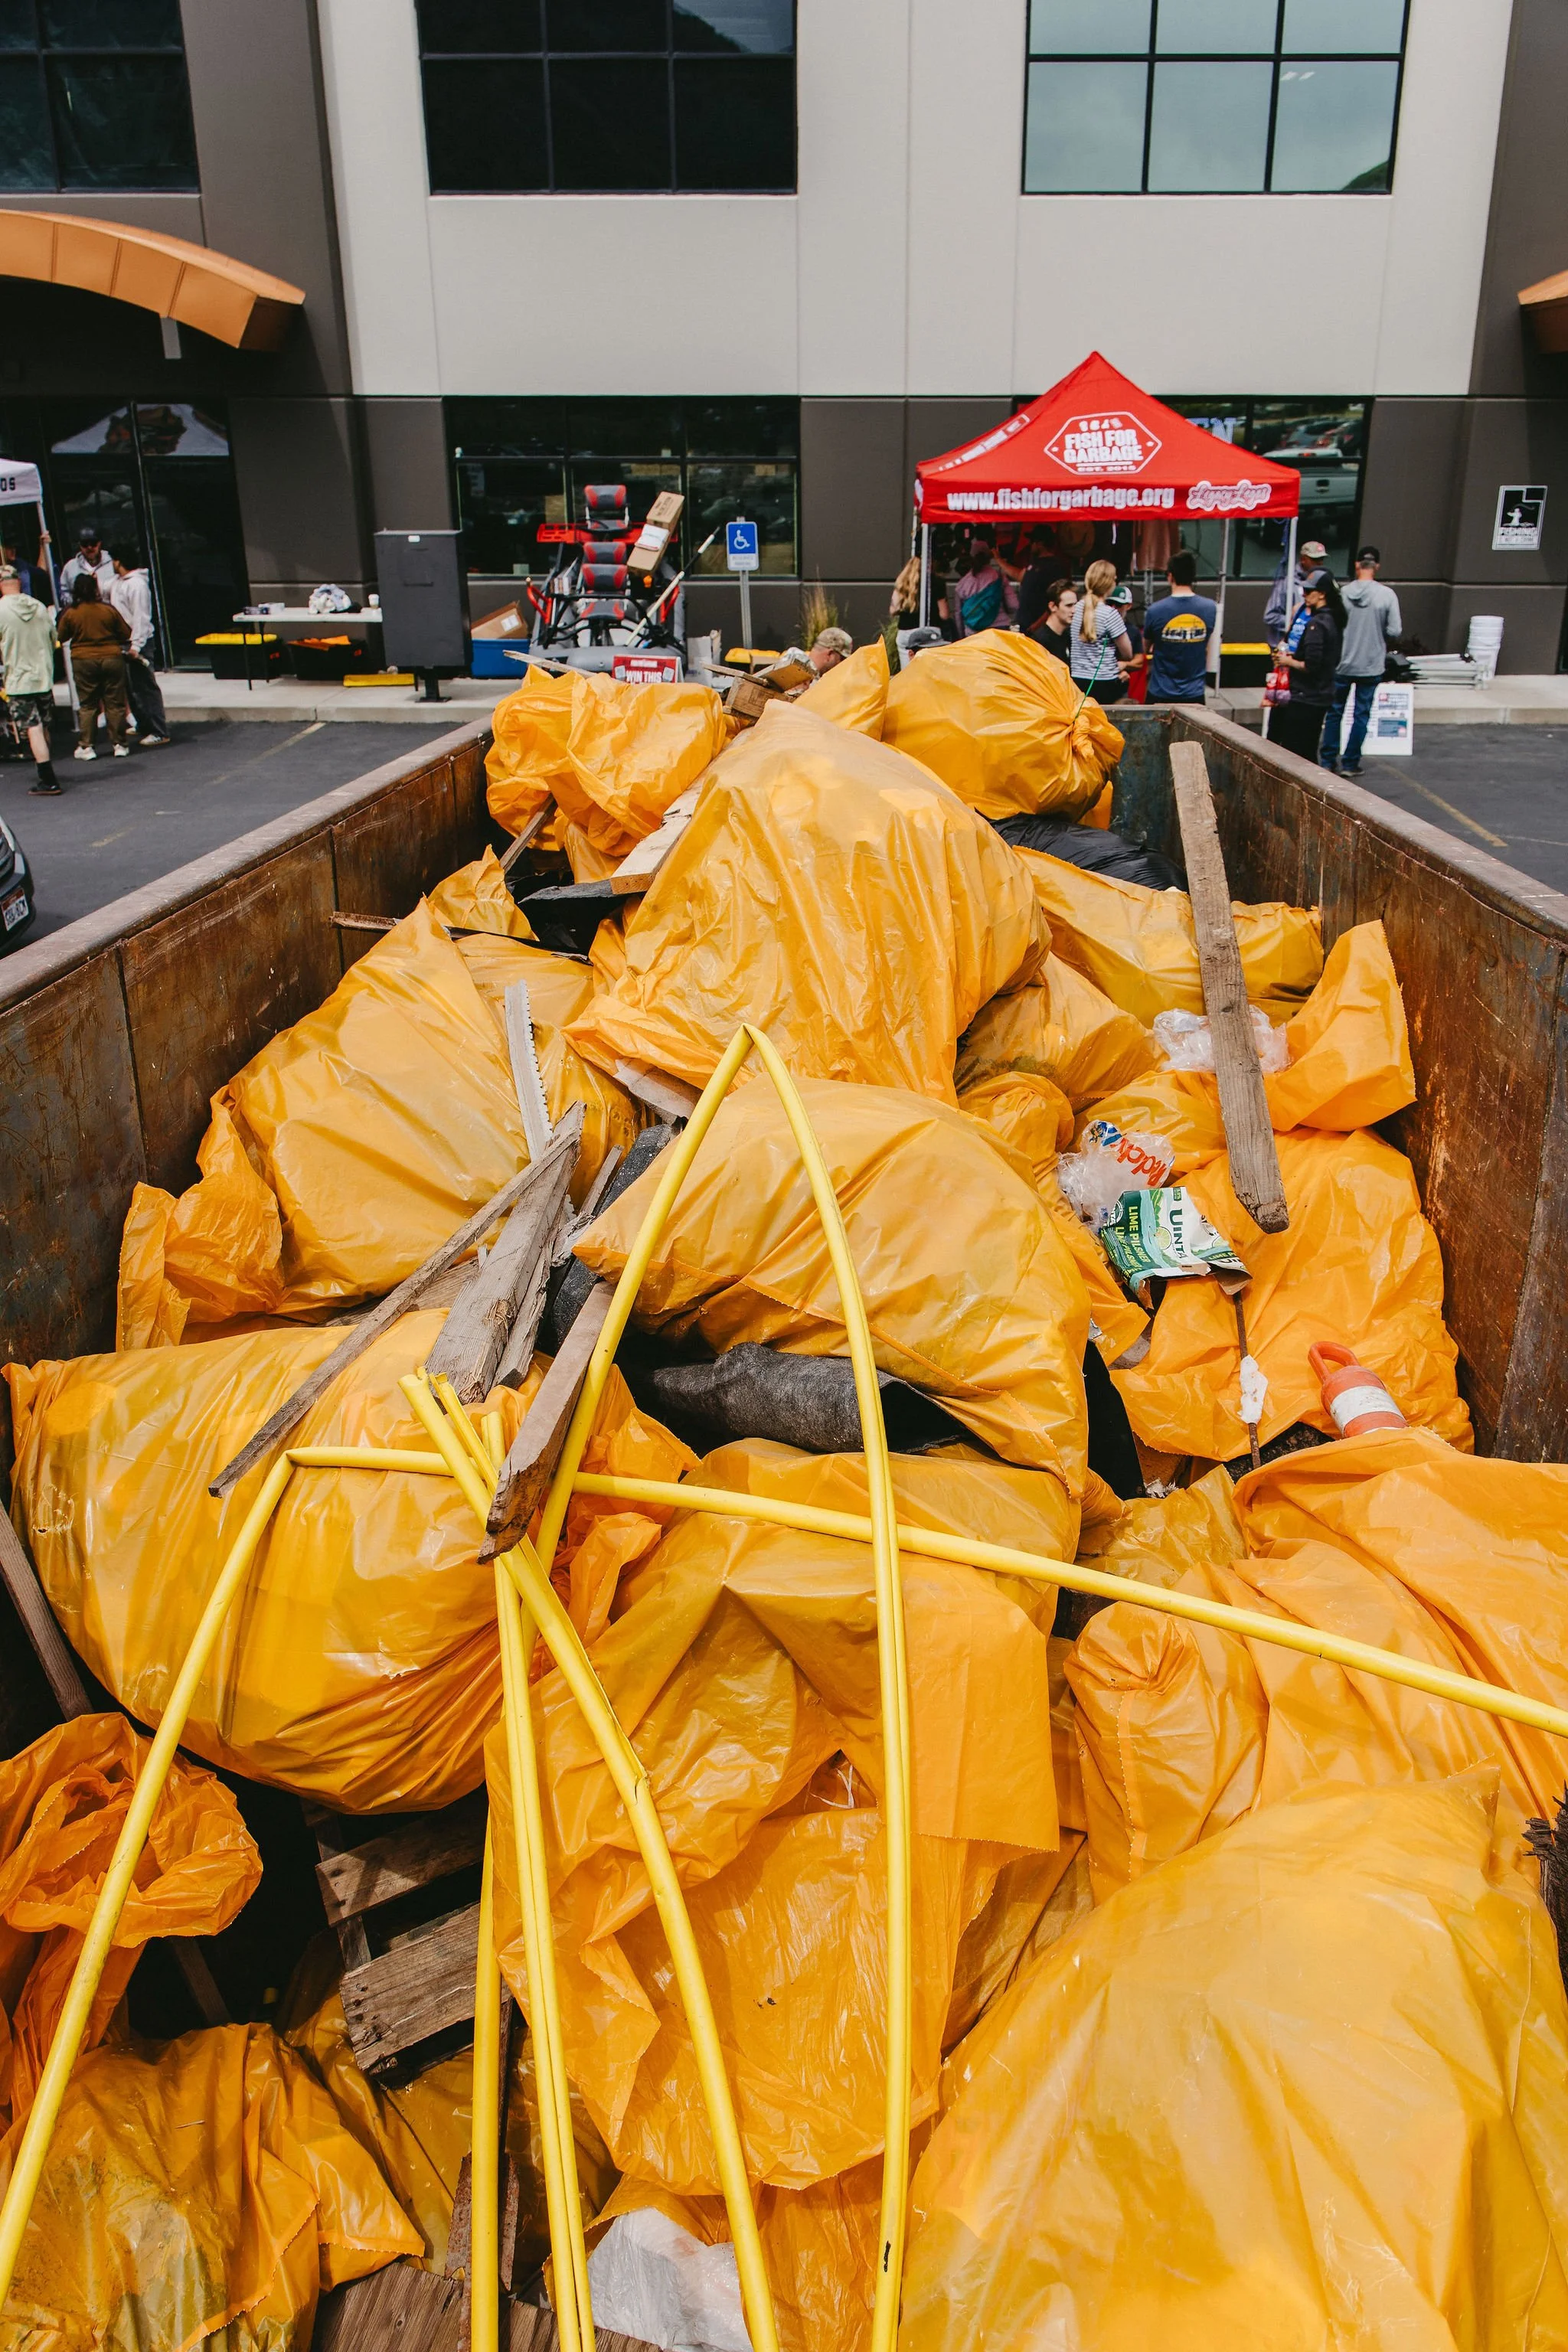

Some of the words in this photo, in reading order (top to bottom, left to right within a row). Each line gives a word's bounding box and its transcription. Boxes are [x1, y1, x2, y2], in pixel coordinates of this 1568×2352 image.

[1064, 430, 1103, 449] FISH
[1105, 429, 1138, 446] FOR
[1063, 445, 1144, 463] GARBAGE
[946, 485, 1175, 511] www.fishforgarbage.org
[626, 671, 642, 683] WIN
[644, 671, 662, 683] THIS
[1129, 1206, 1139, 1232] LIME
[1169, 1208, 1189, 1259] UINTA
[1130, 1233, 1151, 1263] PILSNER
